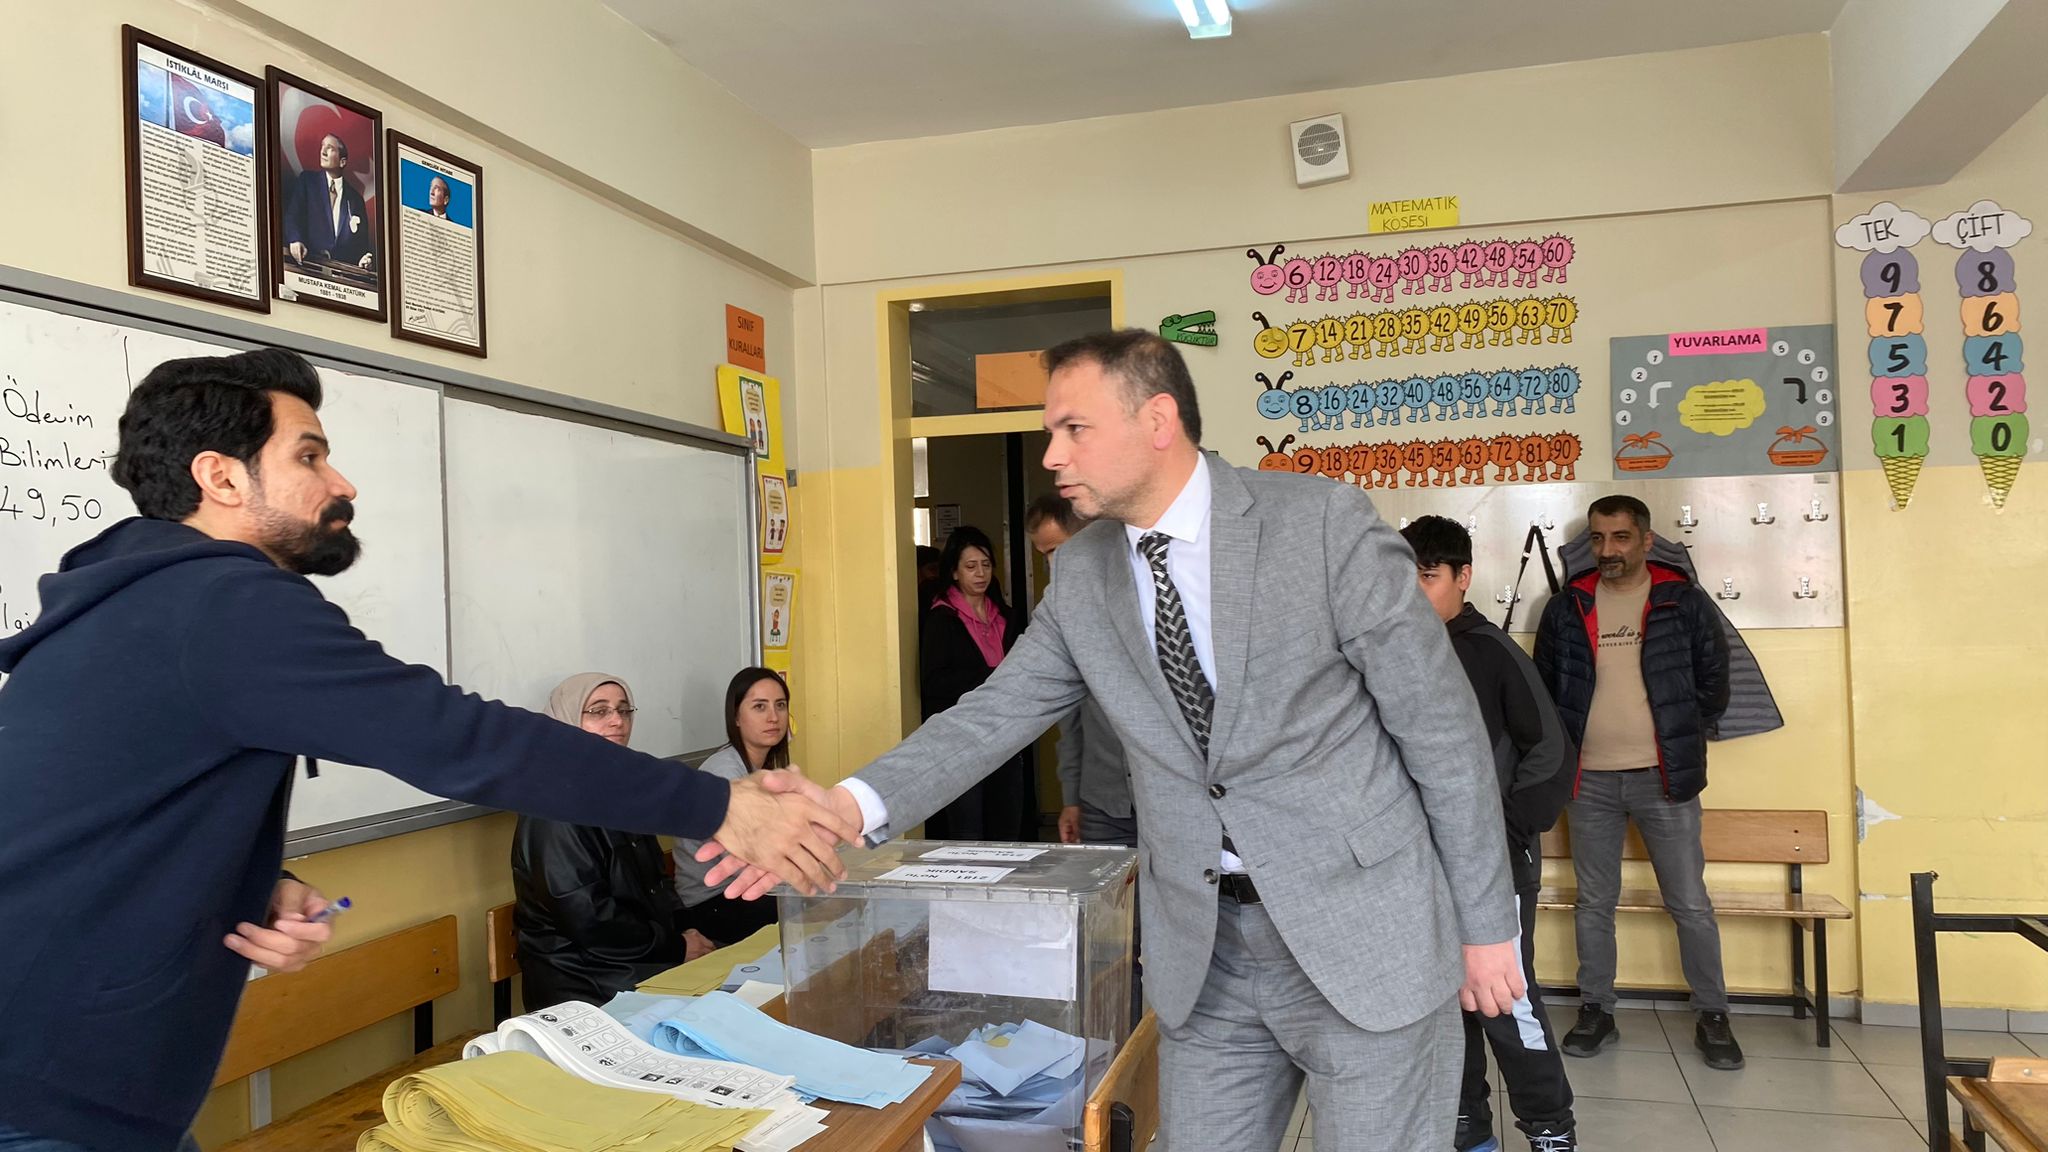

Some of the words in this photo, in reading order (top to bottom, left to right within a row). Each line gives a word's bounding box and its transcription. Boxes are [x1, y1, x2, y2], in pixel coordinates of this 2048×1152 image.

[1860, 218, 1899, 243] TEK
[1957, 213, 2005, 244] ÇİFT
[1289, 266, 1304, 285] 6
[1319, 261, 1336, 281] 12
[1349, 259, 1364, 279] 18
[1375, 263, 1392, 283] 24
[1404, 255, 1420, 275] 30
[1432, 253, 1448, 273] 36
[1462, 249, 1478, 268] 42
[1489, 247, 1506, 266] 48
[1518, 248, 1535, 268] 54
[1546, 242, 1564, 263] 60
[1880, 262, 1901, 293] 9
[1978, 261, 1998, 292] 8
[298, 277, 323, 287] MUSTAFA
[324, 283, 342, 292] KEMAL
[343, 288, 366, 298] ATATÜRK
[1292, 329, 1307, 349] 7
[1321, 322, 1337, 343] 14
[1350, 320, 1367, 341] 21
[1379, 318, 1395, 337] 28
[1405, 314, 1421, 334] 35
[1435, 313, 1450, 332] 42
[1464, 309, 1480, 329] 49
[1491, 305, 1508, 326] 56
[1522, 306, 1539, 326] 63
[1550, 302, 1567, 323] 70
[1883, 302, 1904, 332] 7
[1982, 301, 2004, 332] 6
[1674, 334, 1761, 348] YUVARLAMA
[1779, 345, 1785, 353] 5
[1804, 353, 1811, 361] 6
[1887, 343, 1910, 372] 5
[1982, 341, 2008, 371] 4
[1637, 372, 1643, 380] 2
[1818, 371, 1823, 379] 7
[3, 375, 93, 429] Ödevim
[1296, 395, 1312, 415] 8
[1324, 390, 1340, 410] 16
[1352, 389, 1369, 409] 24
[1381, 386, 1397, 406] 32
[1406, 383, 1423, 402] 40
[1437, 382, 1453, 401] 48
[1465, 378, 1482, 398] 56
[1495, 375, 1511, 396] 64
[1524, 375, 1541, 396] 72
[1552, 372, 1570, 393] 80
[1626, 393, 1632, 401] 3
[1822, 393, 1827, 401] 8
[1891, 384, 1909, 413] 3
[1988, 381, 2008, 411] 2
[1821, 415, 1827, 424] 9
[1891, 424, 1905, 452] 1
[1991, 422, 2012, 451] 0
[1298, 454, 1314, 473] 9
[1326, 451, 1342, 471] 18
[1353, 450, 1368, 470] 27
[1380, 449, 1397, 469] 36
[1408, 448, 1424, 467] 45
[1436, 448, 1452, 467] 54
[1465, 445, 1481, 465] 63
[1495, 441, 1512, 461] 72
[1526, 443, 1543, 463] 81
[1554, 439, 1571, 460] 90
